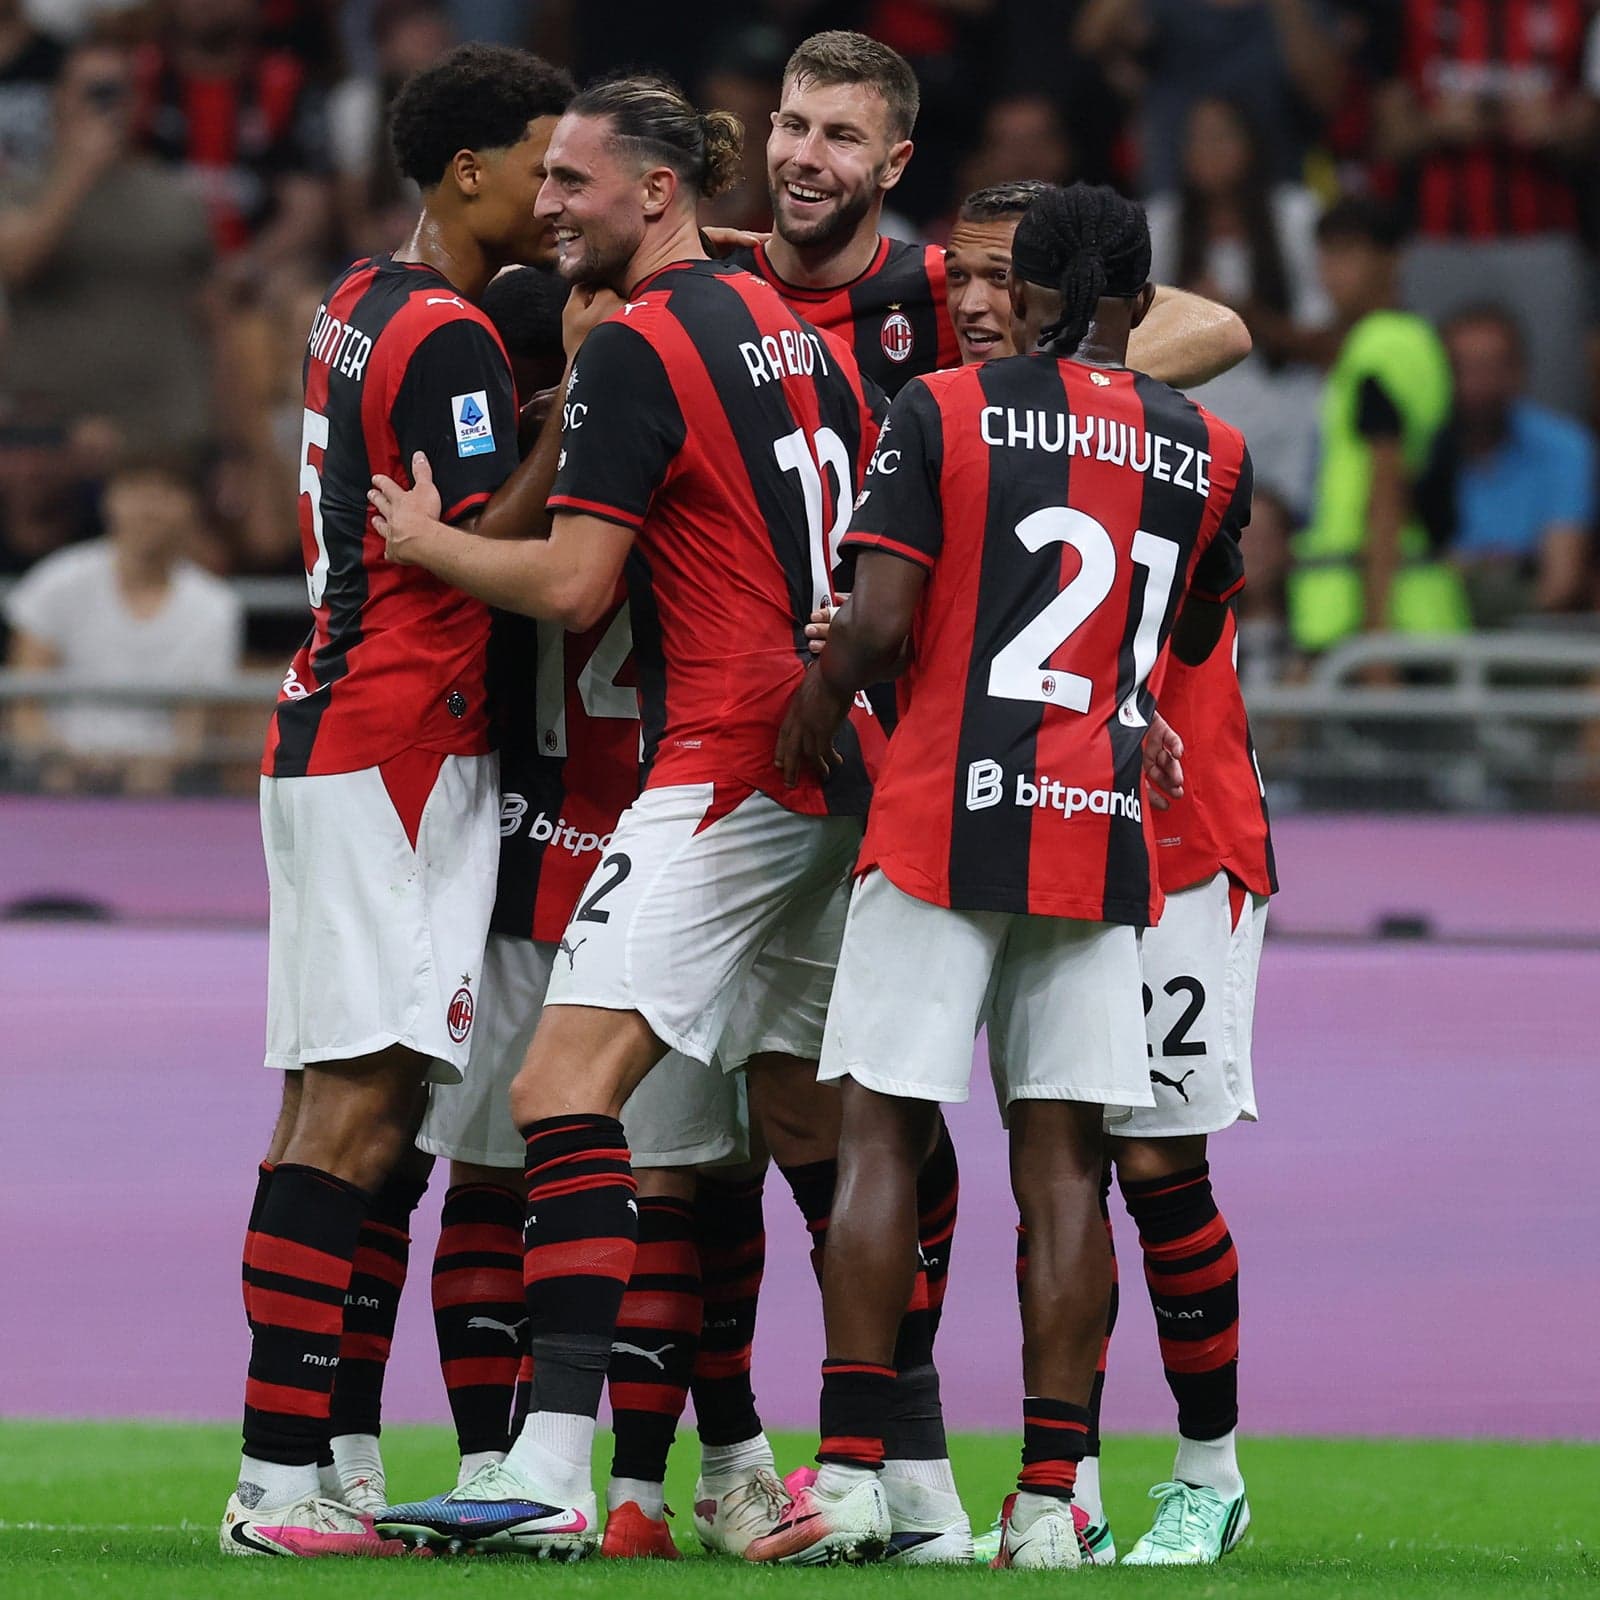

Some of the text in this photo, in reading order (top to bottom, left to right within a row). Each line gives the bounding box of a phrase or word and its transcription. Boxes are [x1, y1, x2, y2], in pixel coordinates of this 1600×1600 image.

[738, 329, 829, 387] RABIOT
[461, 426, 480, 437] SERIE
[980, 406, 1212, 498] CHUKWUEZE
[987, 506, 1180, 728] 21
[1015, 774, 1143, 824] bitpanda
[569, 852, 632, 925] 2
